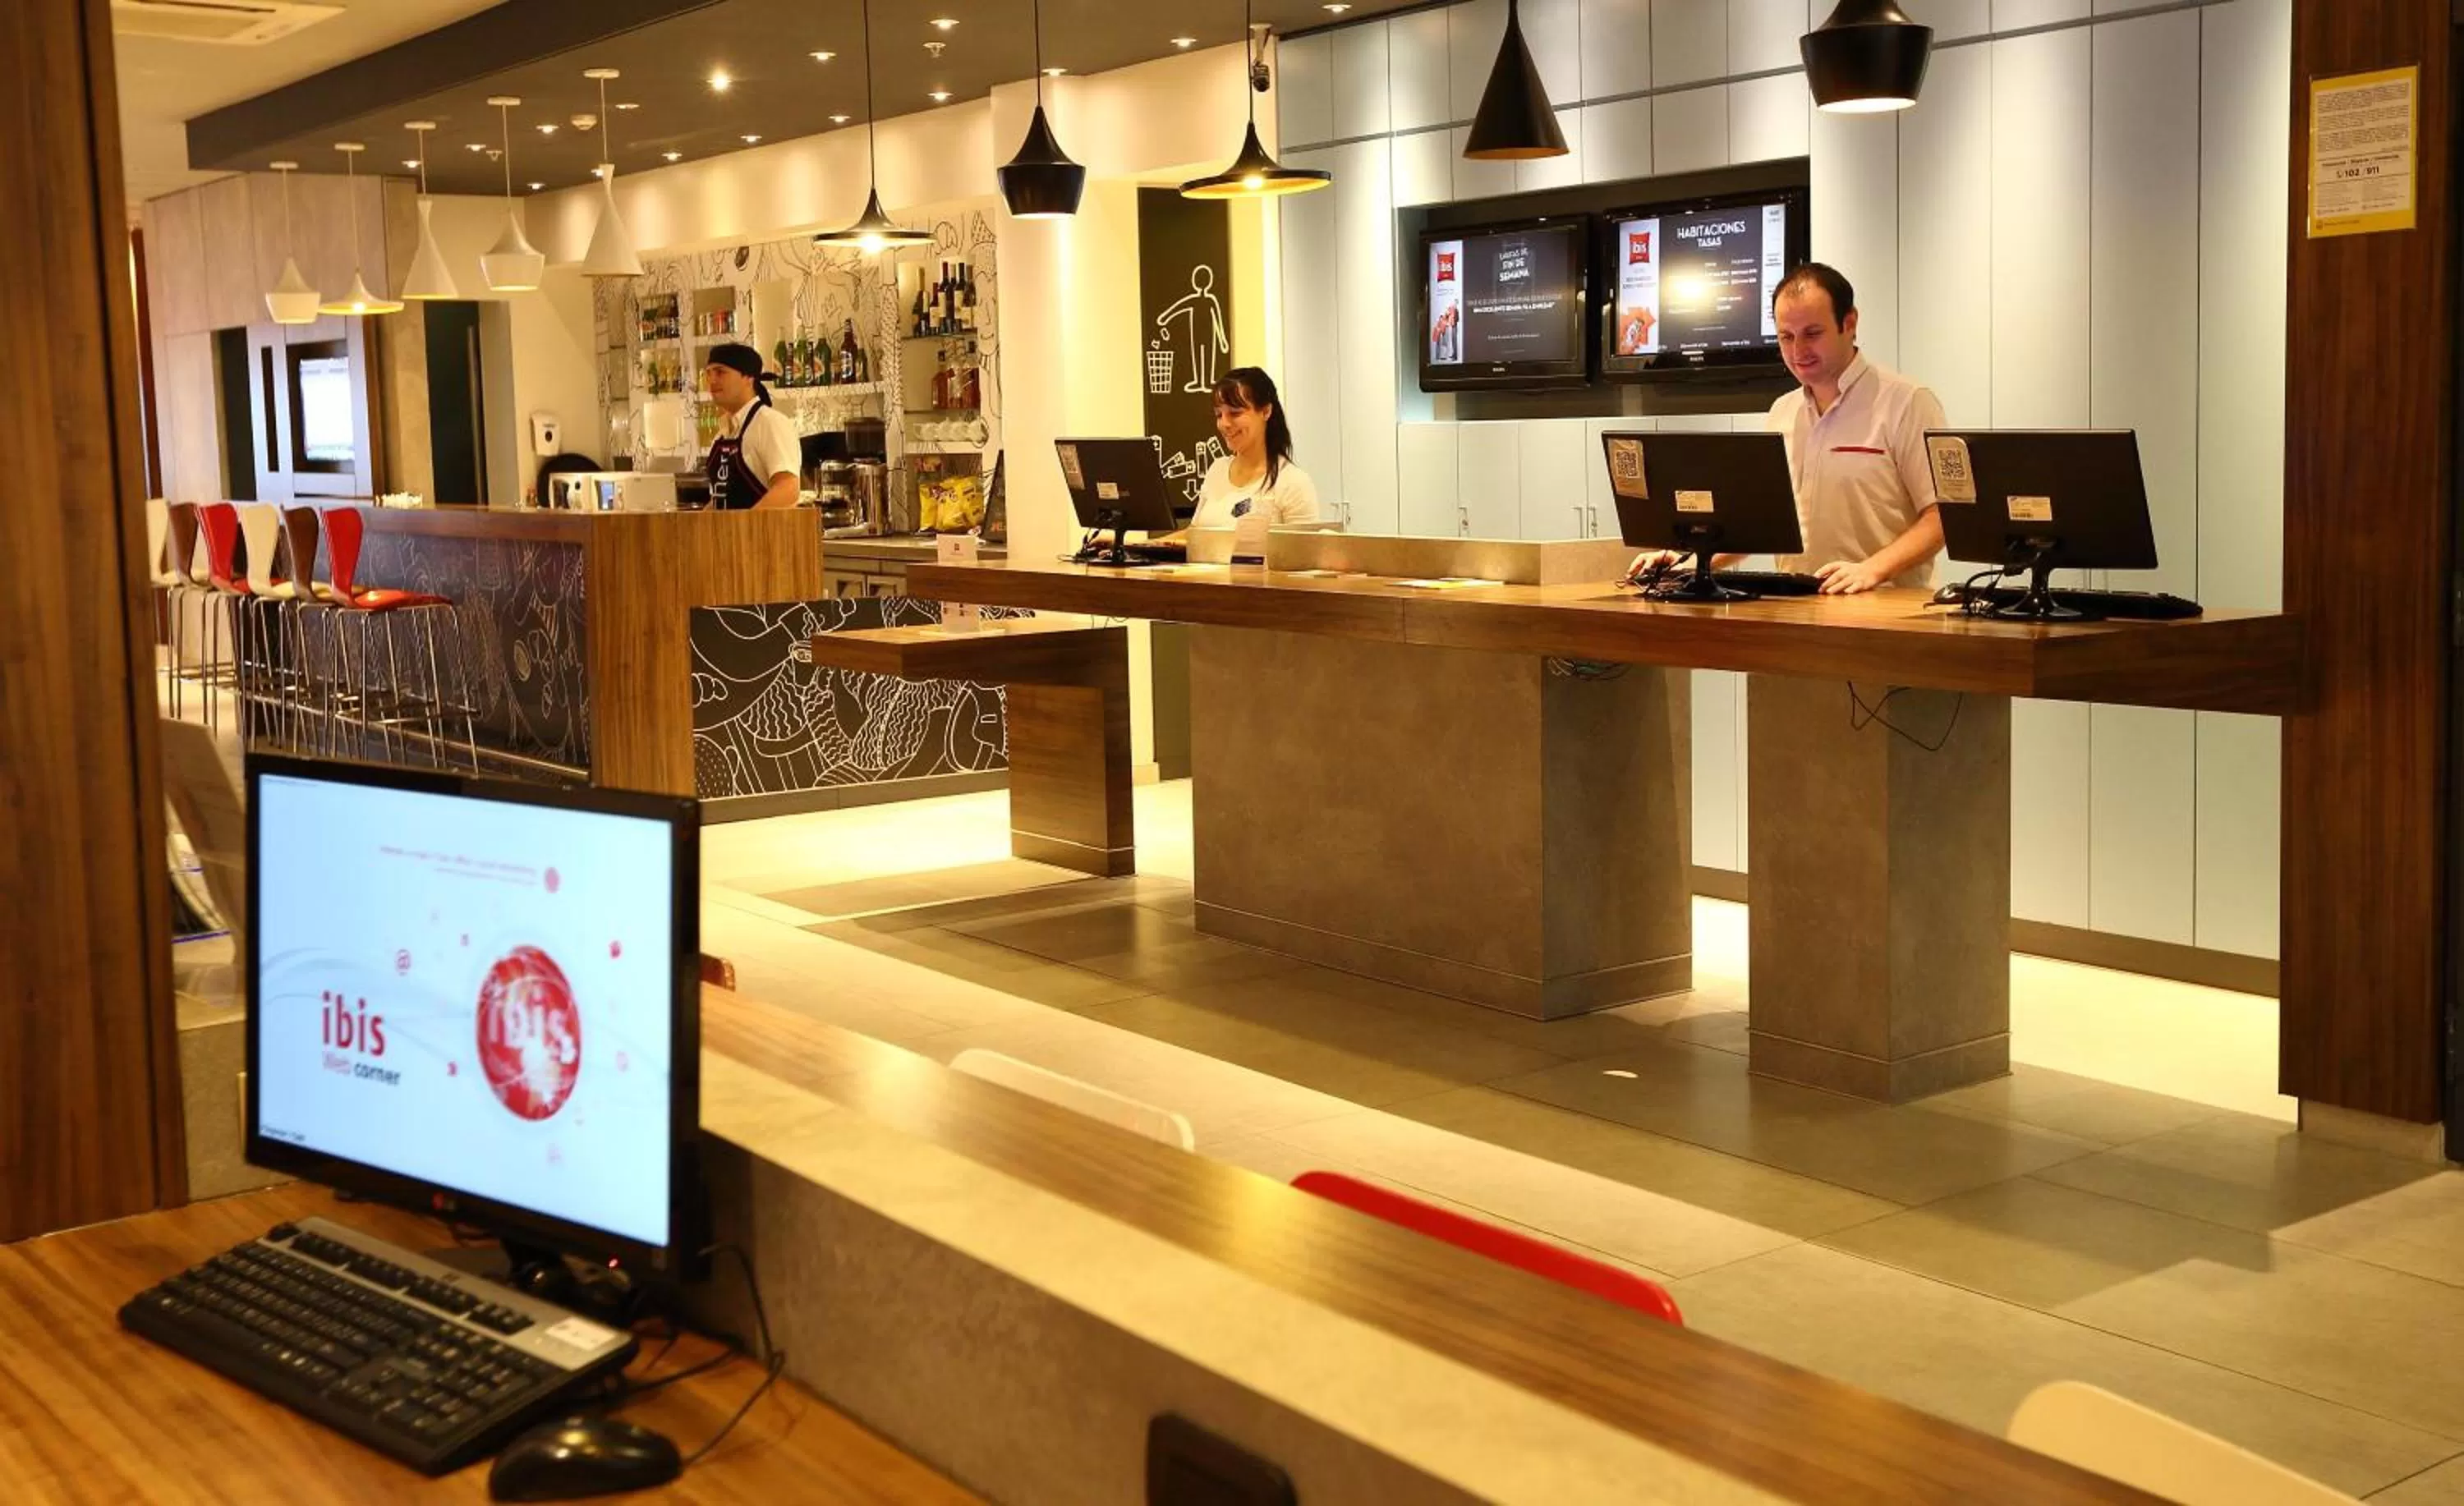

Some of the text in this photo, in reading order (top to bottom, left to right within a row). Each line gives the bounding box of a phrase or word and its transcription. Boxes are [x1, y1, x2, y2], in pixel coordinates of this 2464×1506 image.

[2344, 168, 2360, 178] 102
[2366, 166, 2380, 176] 911
[1677, 221, 1746, 239] HABITACIONES
[1697, 236, 1722, 247] TASAS
[1498, 269, 1530, 282] SEMANA
[323, 990, 385, 1058] ibis
[353, 1062, 401, 1086] corner
